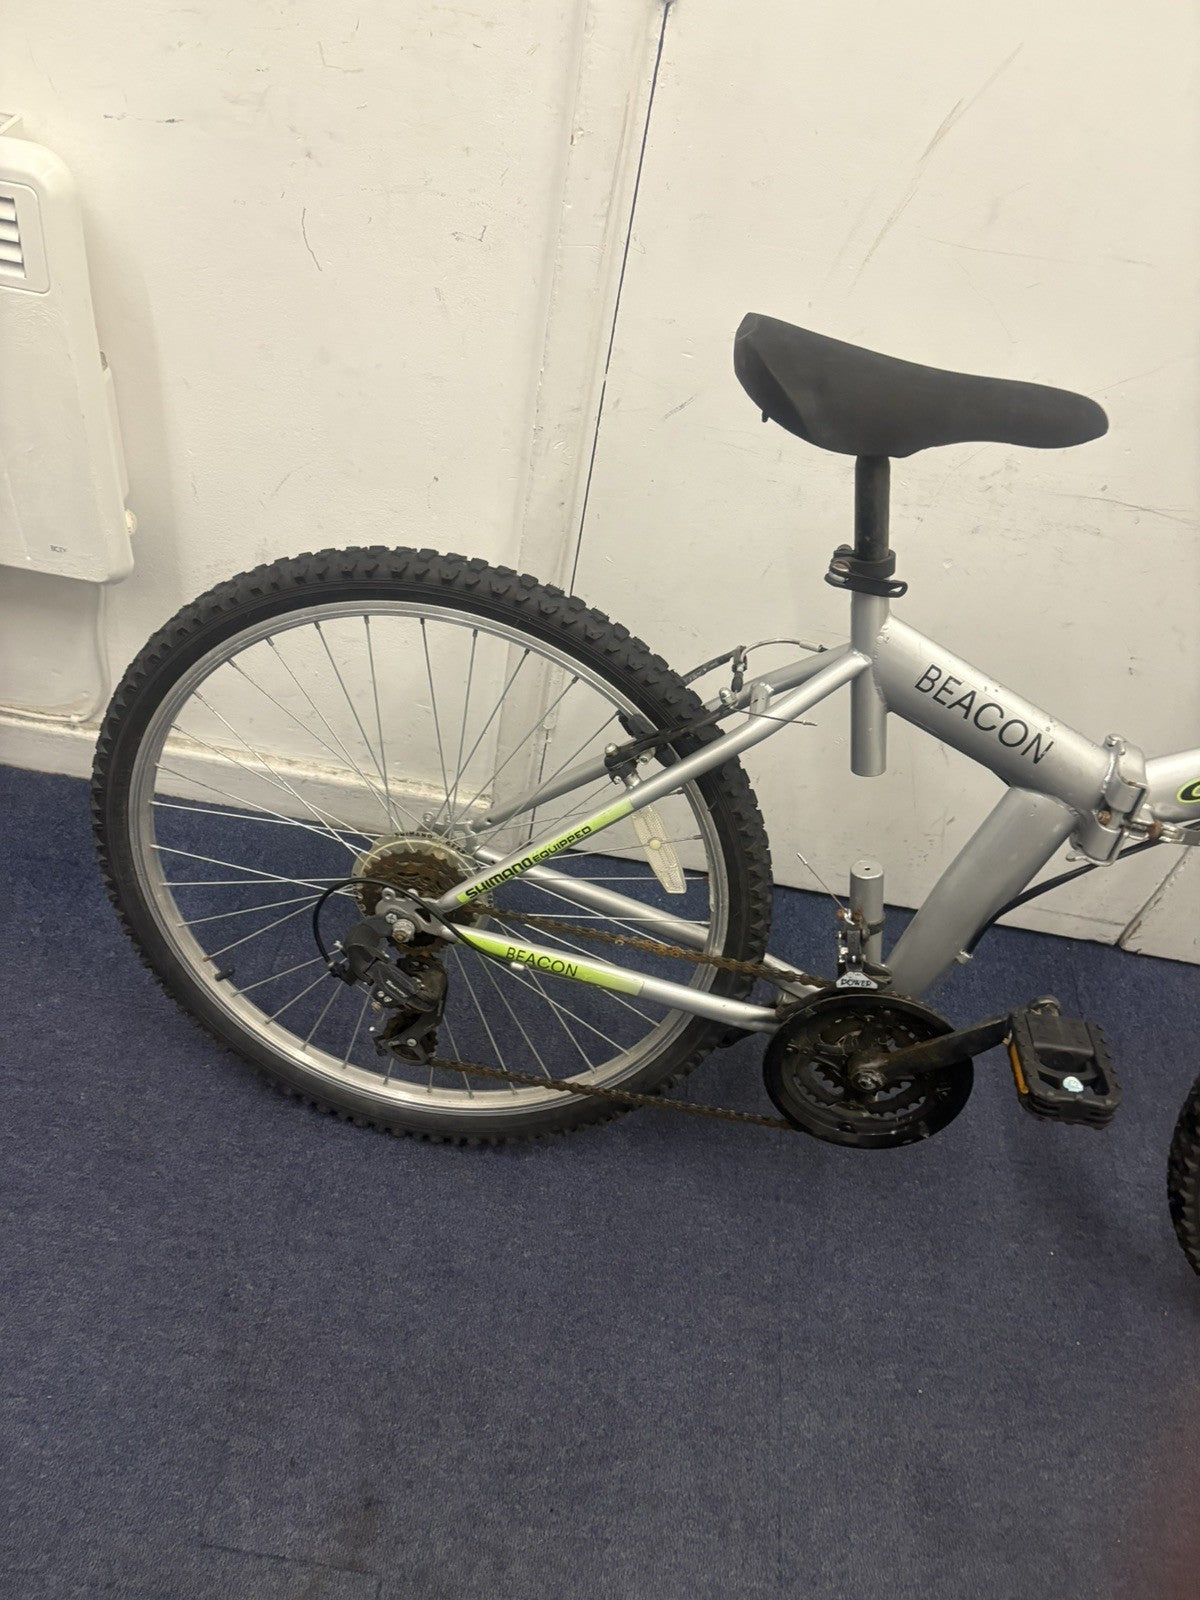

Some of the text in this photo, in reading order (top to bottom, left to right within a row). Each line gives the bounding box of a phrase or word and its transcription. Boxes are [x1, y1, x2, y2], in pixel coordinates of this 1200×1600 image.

[914, 664, 1054, 765] BEACON
[465, 825, 592, 899] SHIMANO EQUIPPED
[505, 946, 578, 977] BEACON
